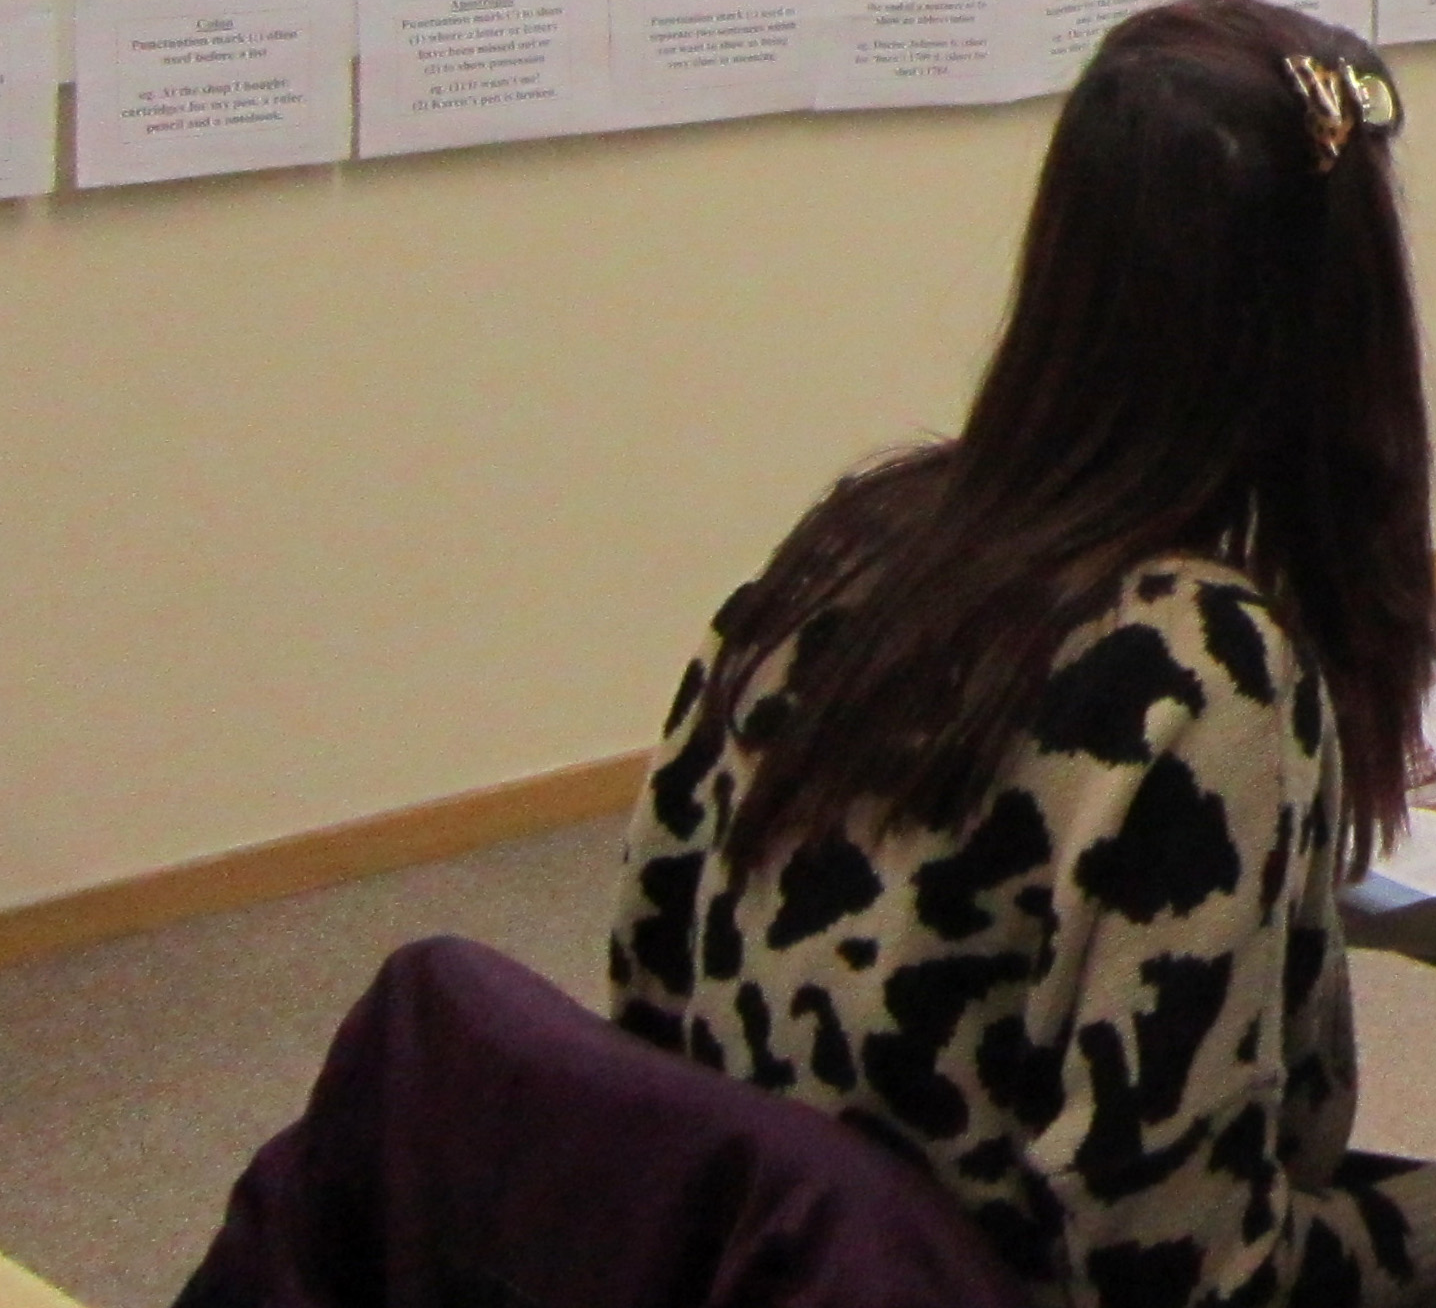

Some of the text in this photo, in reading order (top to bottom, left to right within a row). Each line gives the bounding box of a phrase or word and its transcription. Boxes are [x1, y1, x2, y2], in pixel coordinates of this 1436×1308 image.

[197, 18, 233, 30] Colon
[402, 15, 470, 30] Punctuation
[474, 12, 504, 22] mark
[132, 37, 208, 50] Punctuation
[212, 35, 244, 45] mark
[448, 47, 474, 56] been
[478, 41, 516, 52] missed
[195, 51, 234, 63] before
[481, 94, 501, 106] pen
[146, 119, 183, 133] pencil
[188, 117, 210, 128] and
